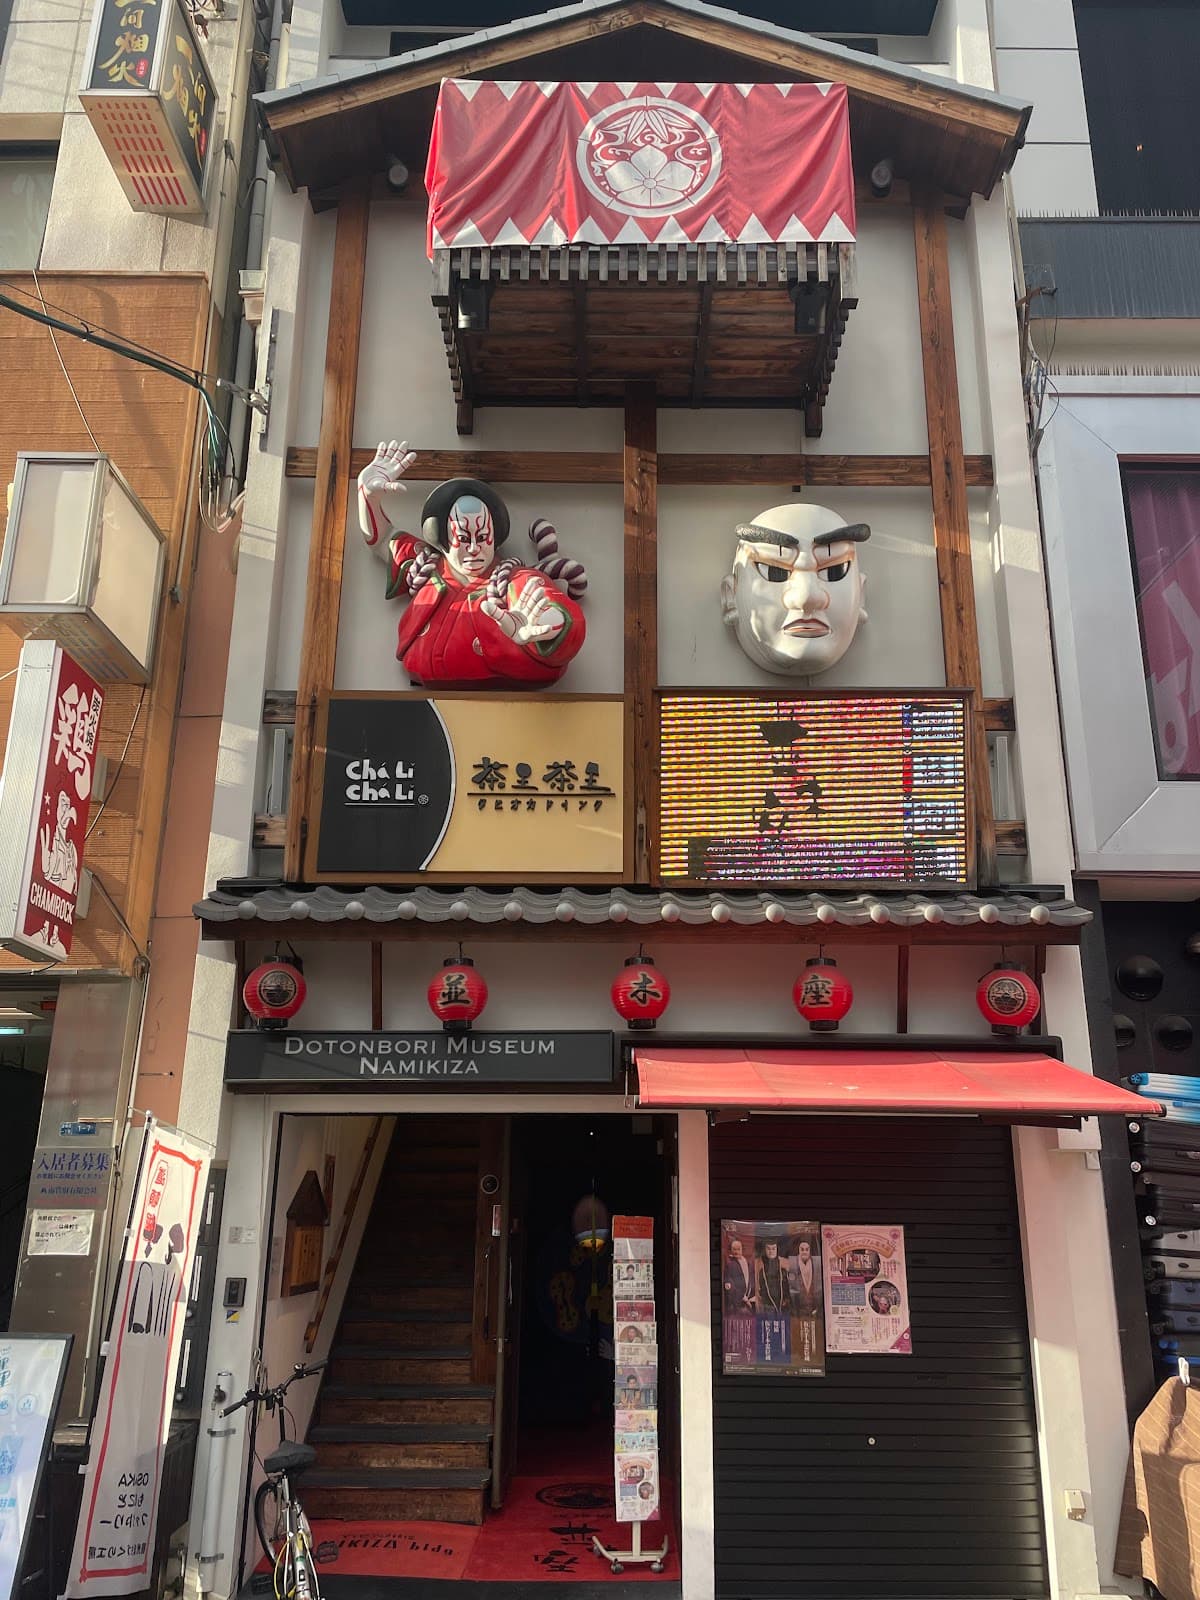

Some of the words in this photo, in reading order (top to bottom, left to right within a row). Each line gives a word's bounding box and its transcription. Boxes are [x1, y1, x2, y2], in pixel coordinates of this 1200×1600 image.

[30, 882, 75, 925] CHAMIROCK
[284, 1036, 437, 1055] DOTONBORI
[446, 1036, 556, 1055] MUSEUM
[359, 1057, 480, 1075] NAMIKIZA
[37, 1151, 110, 1171] 入居者募集
